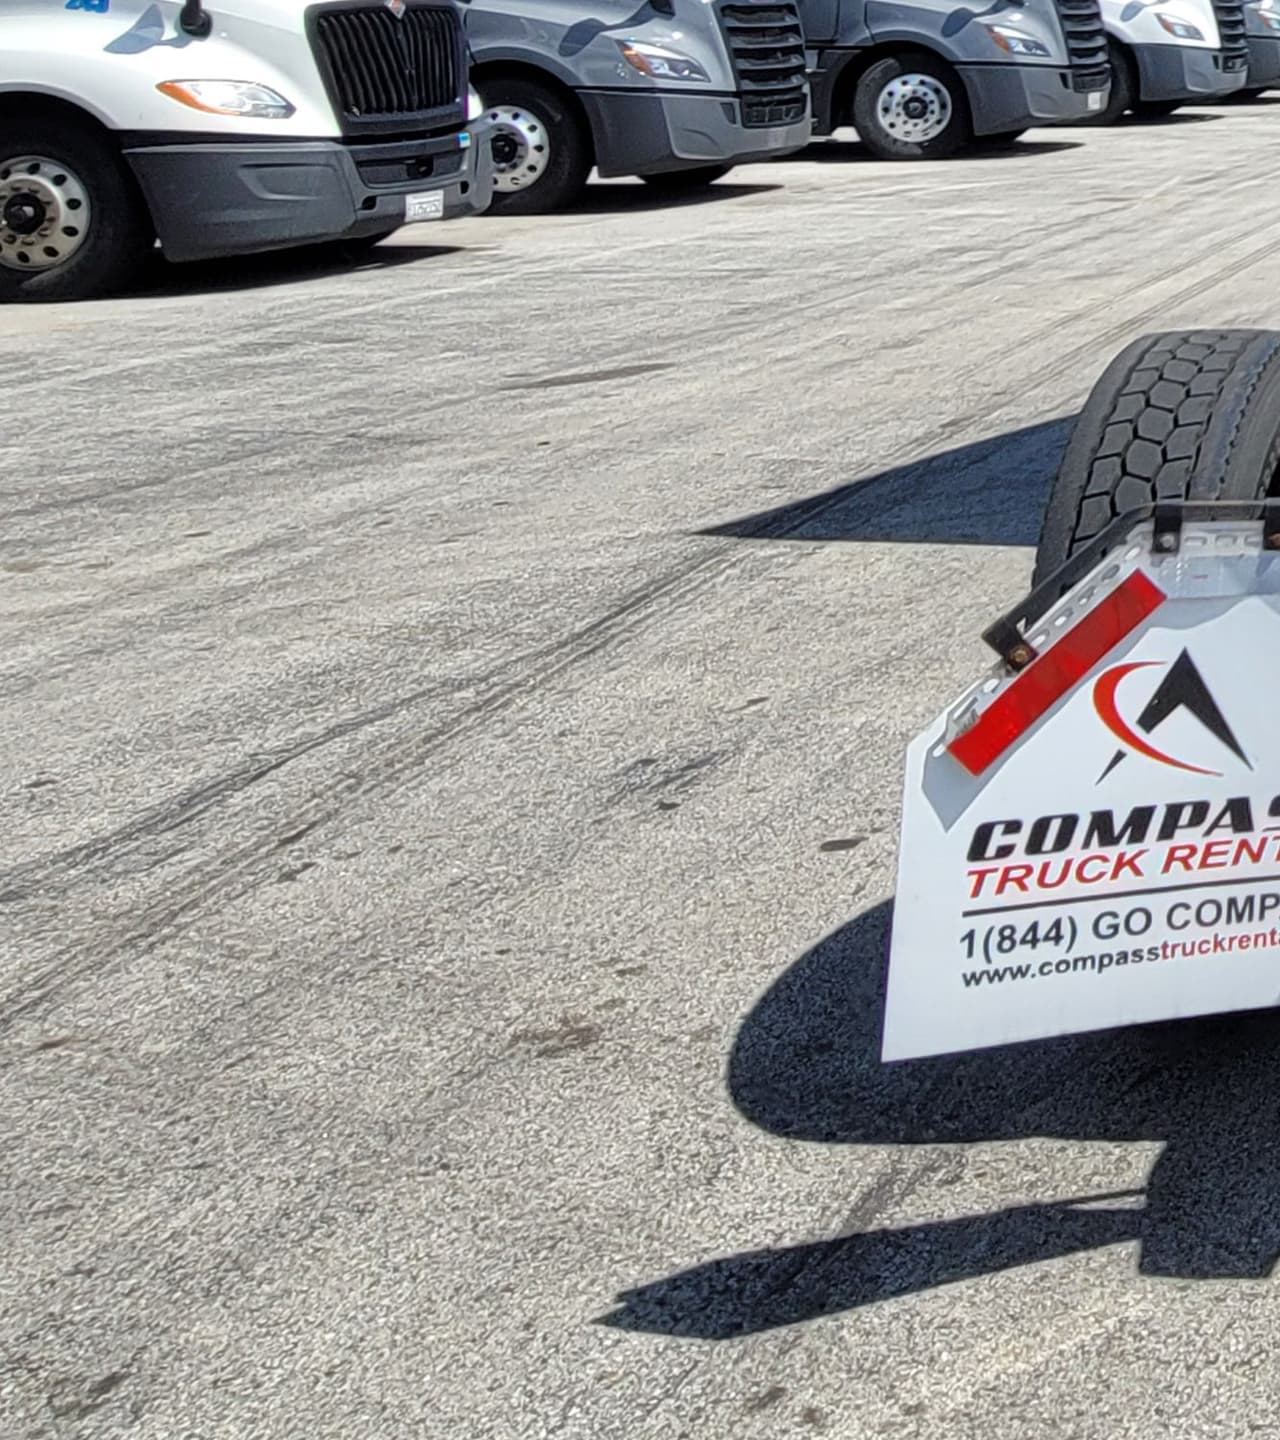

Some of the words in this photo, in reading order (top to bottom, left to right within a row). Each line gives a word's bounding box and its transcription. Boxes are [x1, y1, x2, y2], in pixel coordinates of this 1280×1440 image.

[966, 849, 1151, 899] TRUCK
[959, 916, 1078, 964] 1(844)
[1092, 907, 1153, 941] GO
